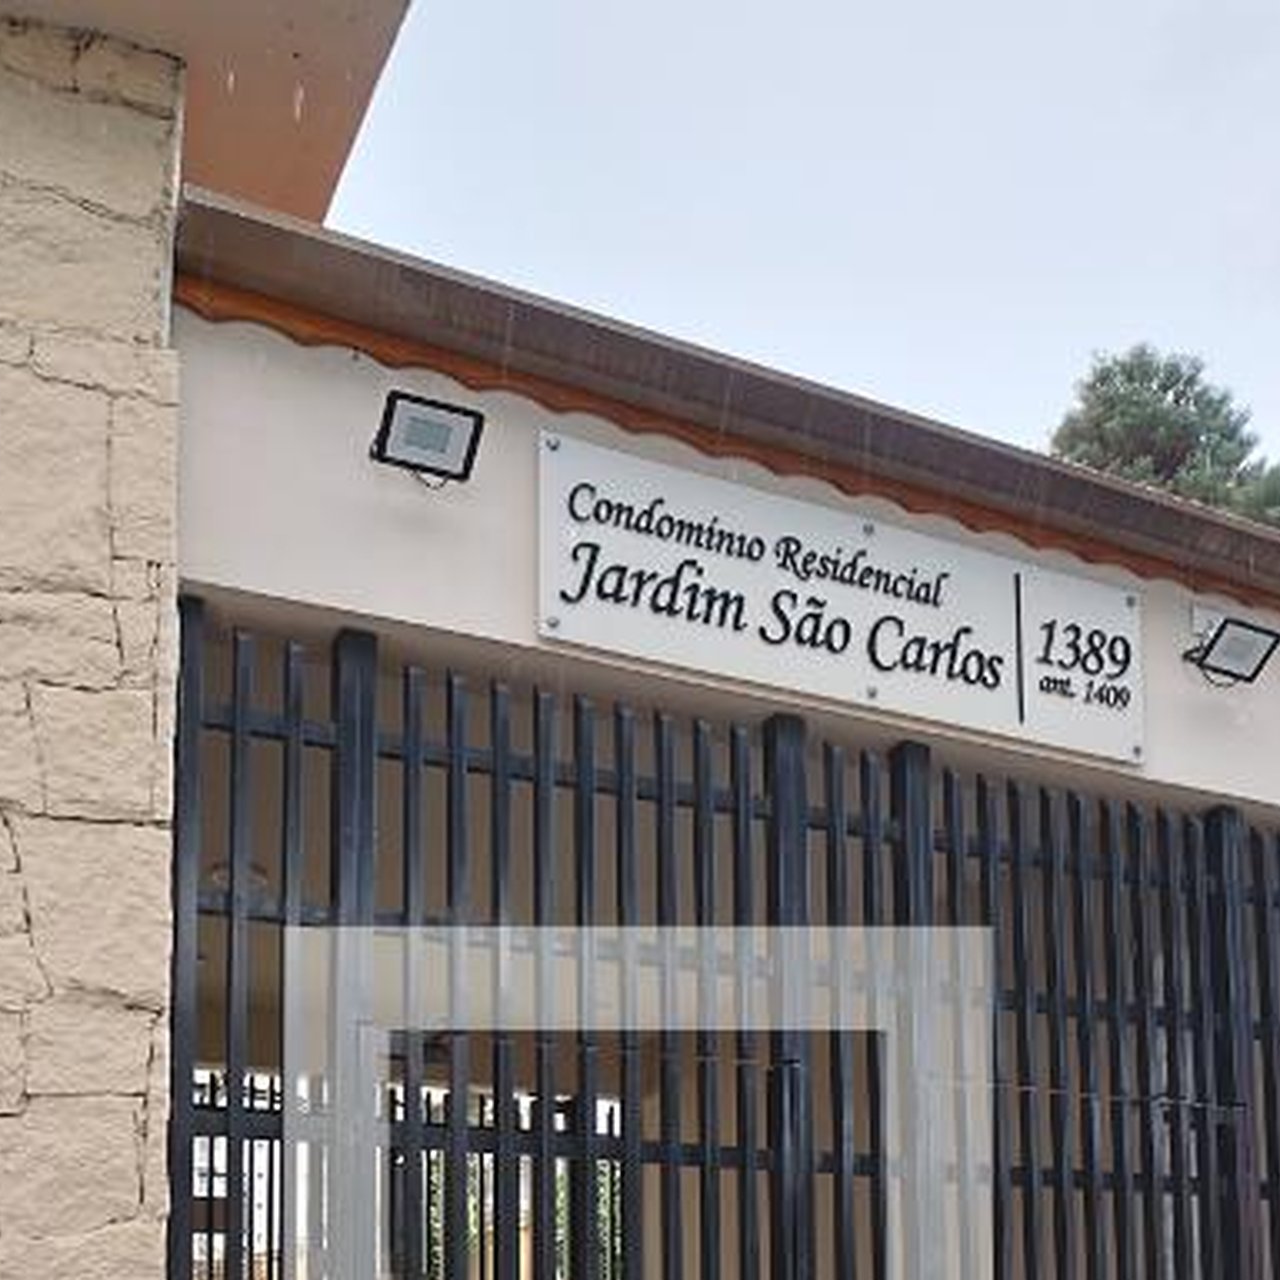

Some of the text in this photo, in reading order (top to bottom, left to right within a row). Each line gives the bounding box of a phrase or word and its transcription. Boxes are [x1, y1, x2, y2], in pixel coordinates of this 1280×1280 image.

[567, 482, 951, 607] Condomínio Residencial
[559, 542, 1005, 689] Jardim São Carlos
[1036, 619, 1132, 679] 1389
[1084, 680, 1132, 711] 1409
